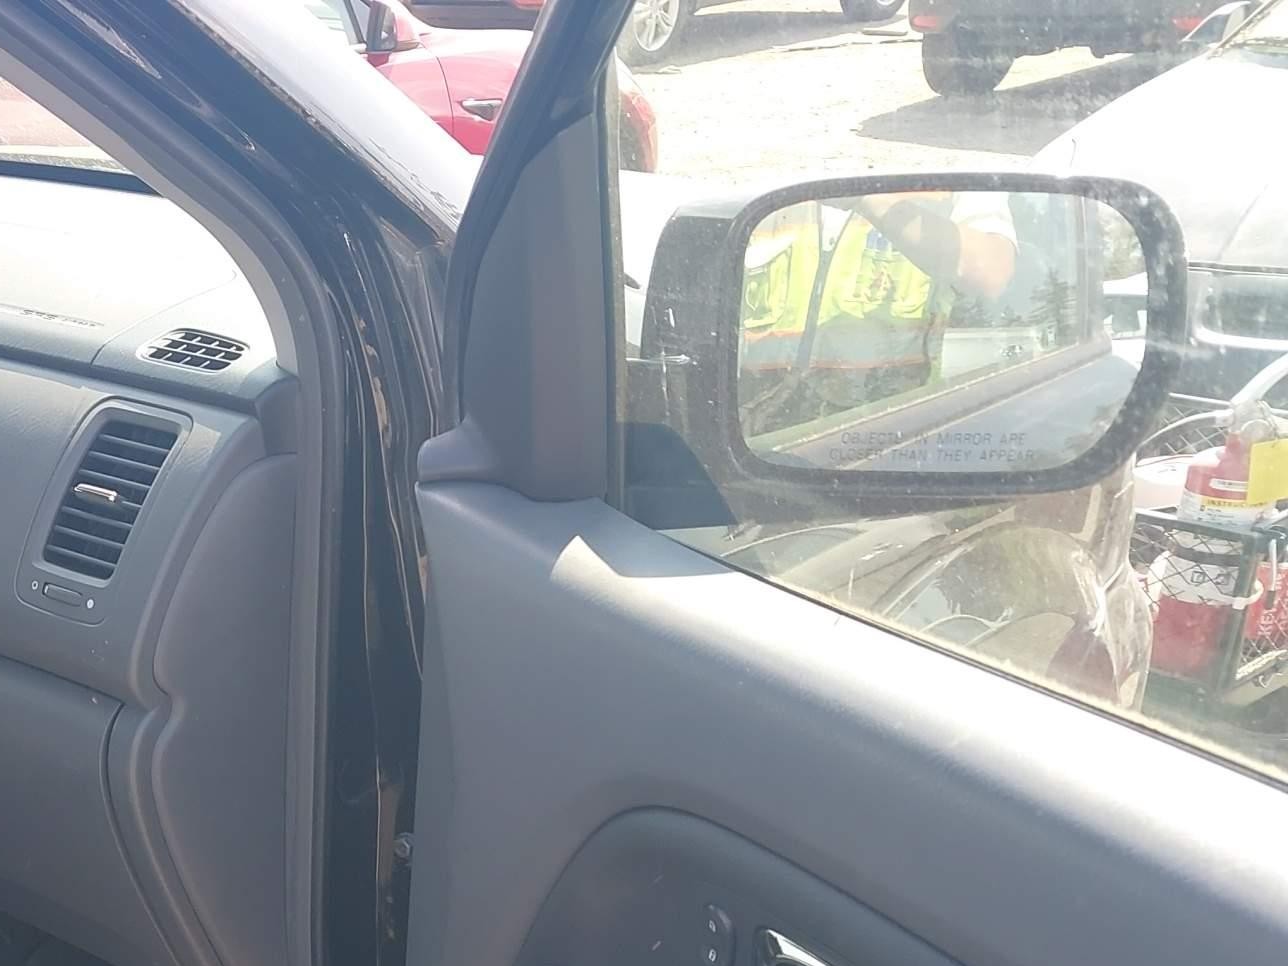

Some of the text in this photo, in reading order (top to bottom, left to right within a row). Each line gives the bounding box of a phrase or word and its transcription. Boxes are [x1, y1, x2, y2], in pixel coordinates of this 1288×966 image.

[936, 432, 992, 446] MIRROR
[1000, 432, 1028, 446] ARE
[890, 448, 928, 462] THAN
[936, 449, 973, 462] THEY
[979, 449, 1034, 462] APPEAR
